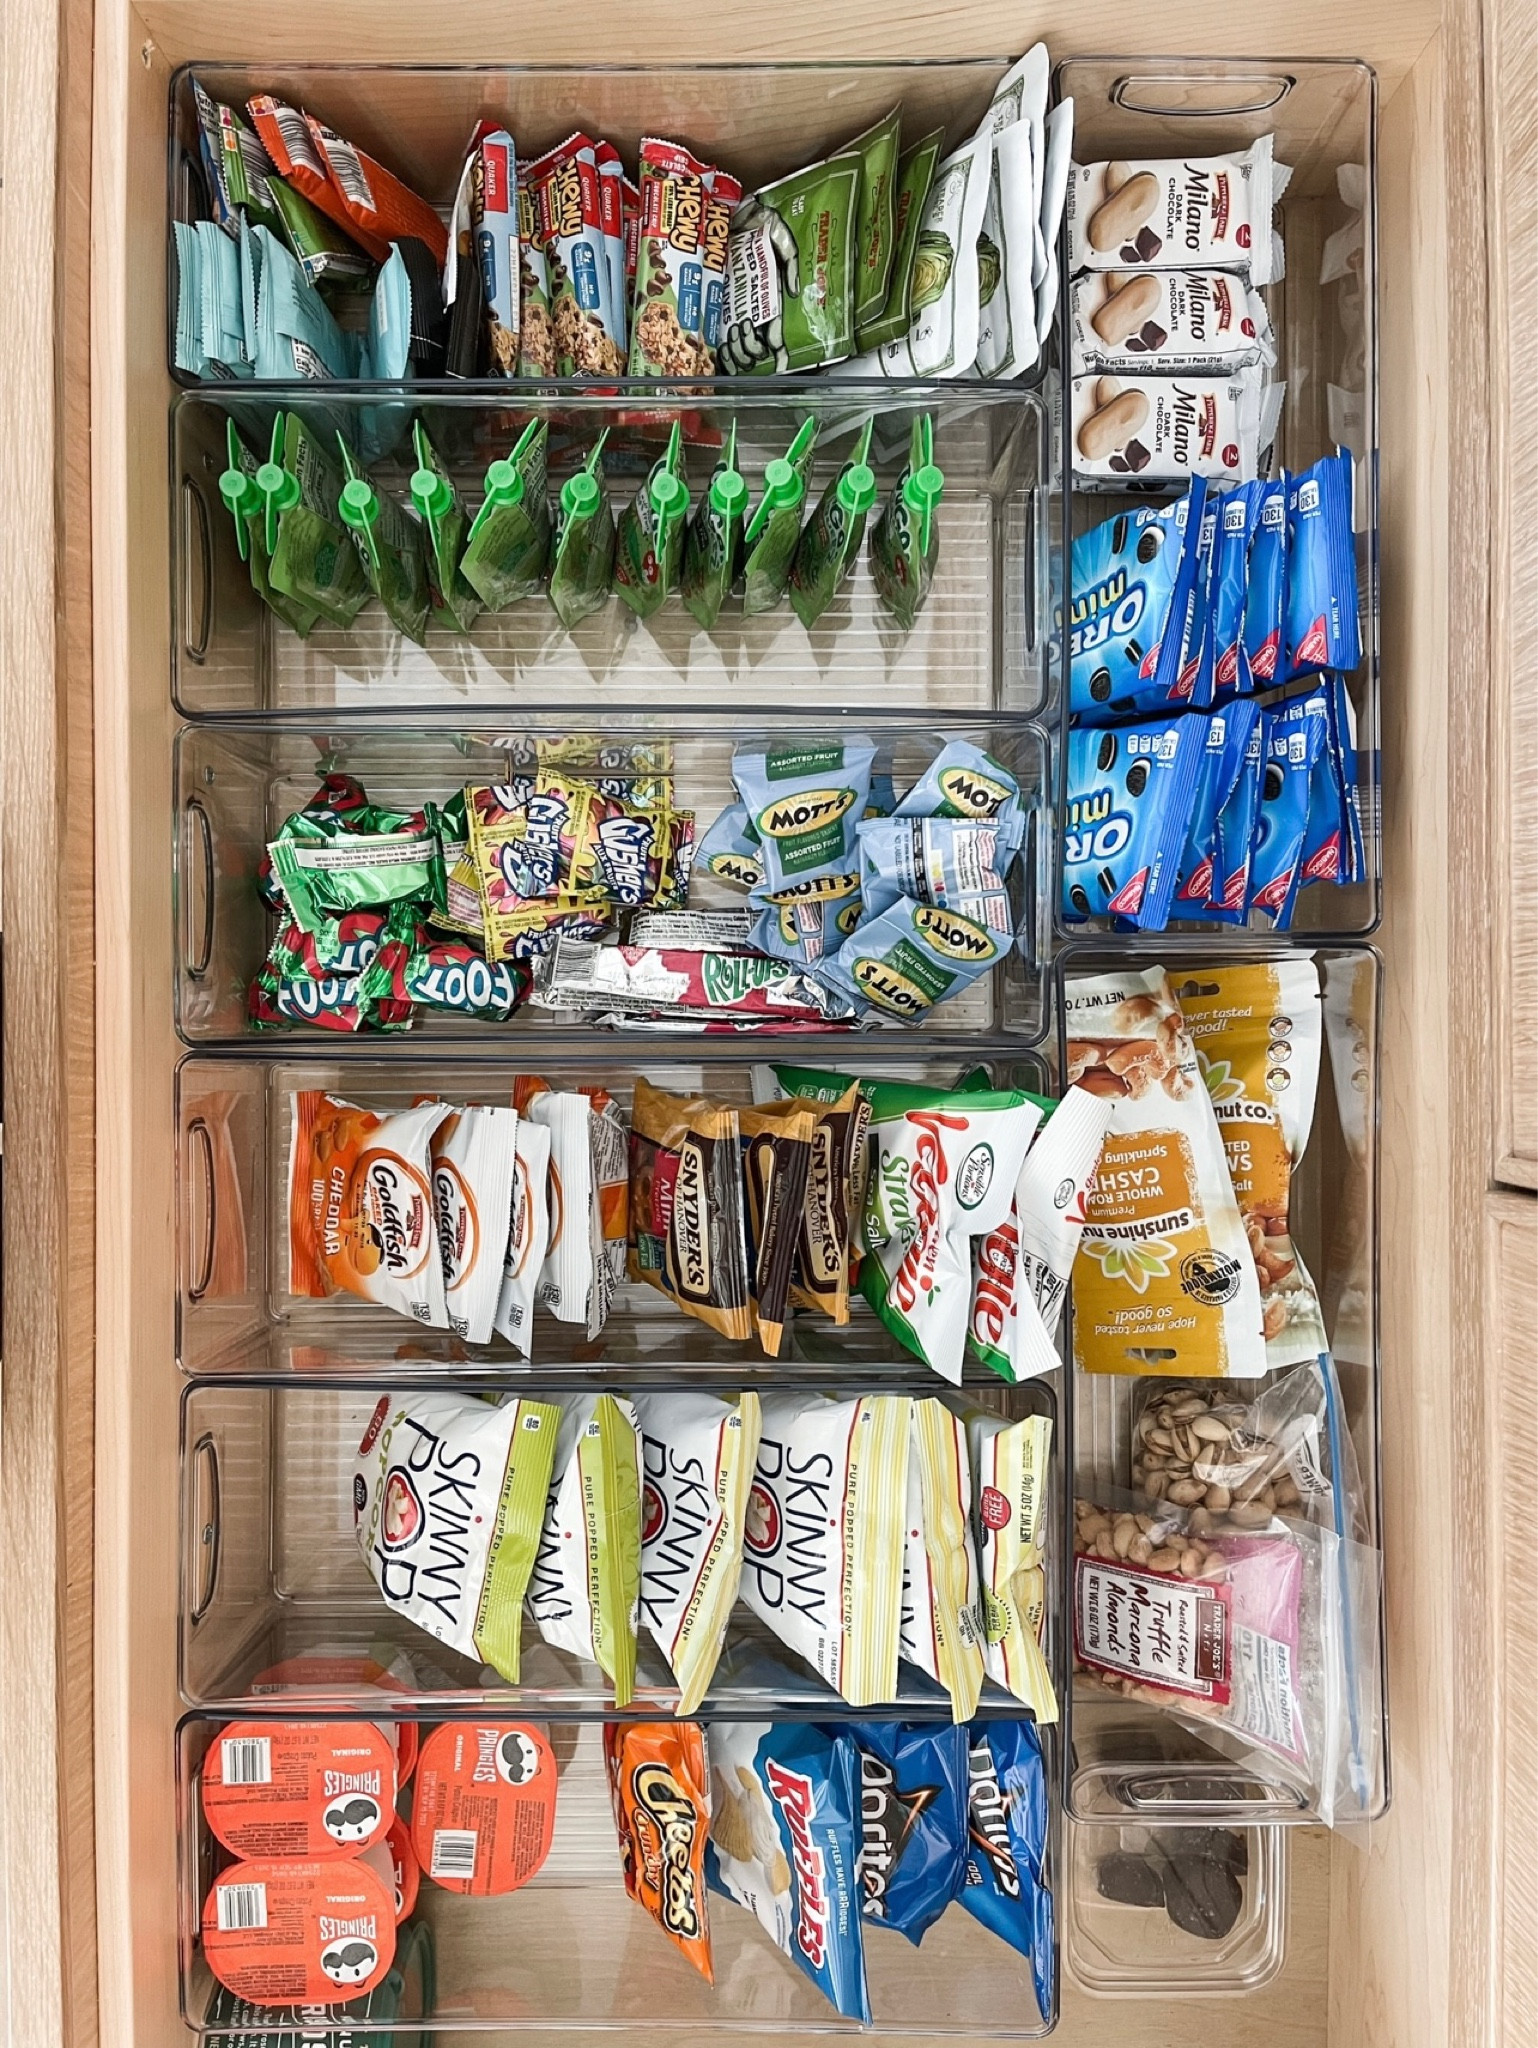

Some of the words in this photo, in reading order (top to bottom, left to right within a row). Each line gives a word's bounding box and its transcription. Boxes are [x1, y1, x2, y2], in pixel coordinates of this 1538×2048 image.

[487, 161, 496, 195] QUAKER
[582, 176, 592, 212] QUAKER
[604, 187, 612, 221] QUAKER
[653, 181, 661, 213] CHOCOLATE
[1166, 178, 1177, 240] CHOCOLATE
[1175, 194, 1184, 223] DARK
[1184, 163, 1209, 249] Milano
[730, 235, 749, 321] MANZANILLA
[756, 243, 770, 281] HANDFUL
[722, 273, 732, 325] OLIVES
[750, 274, 760, 323] SALTED
[761, 291, 771, 320] OLIVES
[1169, 278, 1179, 332] CHOCOLATE
[1177, 291, 1186, 316] DARK
[1182, 272, 1211, 341] Milano
[1156, 396, 1164, 454] CHOCOLATE
[1172, 383, 1196, 463] Milano
[1261, 507, 1283, 523] 130
[1299, 494, 1317, 509] 130
[1225, 516, 1242, 528] 130
[770, 755, 813, 768] ASSORTED
[814, 752, 839, 760] FRUIT
[552, 813, 569, 840] FRUIT
[593, 844, 606, 862] AUX
[638, 836, 654, 863] FRUIT
[784, 842, 823, 861] ASSORTED
[822, 835, 841, 848] FRUIT
[894, 949, 916, 967] FRUIT
[702, 952, 791, 1004] ROLL-UPS
[913, 962, 946, 990] ASSORTED
[1082, 994, 1104, 1008] WT.
[1106, 991, 1126, 1005] NET
[1212, 1005, 1253, 1019] tasted
[1244, 1103, 1273, 1120] co.
[1104, 1144, 1168, 1165] Sprinkling
[852, 1171, 860, 1189] Less
[865, 1166, 881, 1208] Sea
[959, 1158, 981, 1200] Portions
[972, 1152, 991, 1198] Sensible
[813, 1133, 841, 1274] SNYDER'S
[1116, 1185, 1164, 1203] WHOLE
[323, 1166, 346, 1256] CHEDDAR
[372, 1164, 408, 1268] Goldfish
[435, 1174, 457, 1280] Goldfish
[676, 1192, 688, 1252] HANOVER
[683, 1150, 705, 1286] SNYDER'S
[771, 1203, 781, 1224] Pretzel
[808, 1181, 823, 1245] HANOVER
[1092, 1205, 1136, 1218] Premium
[1106, 1211, 1189, 1243] sunshine
[767, 1225, 778, 1247] Bakery
[865, 1211, 886, 1249] Salt
[1180, 1259, 1242, 1295] MOZAMBIQUE
[550, 1287, 561, 1304] 130
[419, 1305, 431, 1320] 130
[457, 1320, 468, 1336] 130
[515, 1309, 524, 1325] 130
[1115, 1305, 1154, 1324] good!
[1137, 1322, 1165, 1333] never
[1156, 1306, 1174, 1319] so
[1169, 1317, 1197, 1329] Hope
[1094, 1325, 1134, 1337] tasted
[501, 1466, 516, 1499] PURE
[585, 1475, 594, 1508] PURE
[845, 1463, 859, 1496] PURE
[1021, 1474, 1034, 1492] (14g)
[373, 1417, 441, 1602] POP
[845, 1500, 857, 1550] POPPED
[989, 1494, 1003, 1524] FREE
[1020, 1513, 1032, 1527] WT
[417, 1440, 482, 1626] SKINNY
[492, 1503, 507, 1550] POPPED
[588, 1512, 598, 1561] POPPED
[639, 1447, 713, 1629] SKINNY
[785, 1446, 837, 1631] SKINNY
[1020, 1528, 1032, 1544] NET
[476, 1555, 497, 1633] PERFECTION
[683, 1556, 717, 1636] PERFECTION
[843, 1554, 854, 1632] PERFECTION
[1089, 1575, 1100, 1592] NET
[590, 1566, 603, 1643] PERFECTION
[990, 1605, 999, 1618] BAG
[1089, 1614, 1100, 1625] OZ
[1105, 1581, 1128, 1655] Almonds
[1178, 1599, 1189, 1634] Roasted
[992, 1619, 1001, 1631] PER
[1127, 1582, 1151, 1667] Marcona
[1147, 1600, 1172, 1664] Truffle
[1212, 1605, 1222, 1640] TRADER
[1177, 1645, 1188, 1675] Salted
[1212, 1642, 1222, 1670] JOE'S
[331, 1748, 372, 1757] ORIGINAL
[454, 1734, 464, 1772] ORIGINAL
[472, 1728, 500, 1783] PRINGLES
[324, 1769, 381, 1797] PRINGLES
[634, 1808, 664, 1891] Crunchy
[635, 1765, 698, 1938] Cheetos
[860, 1752, 893, 1918] Doritos
[766, 1760, 825, 1969] RUFFLES
[826, 1828, 843, 1865] RUFFLES
[836, 1866, 847, 1889] HAVE
[326, 1894, 367, 1903] ORIGINAL
[319, 1914, 377, 1940] PRINGLES
